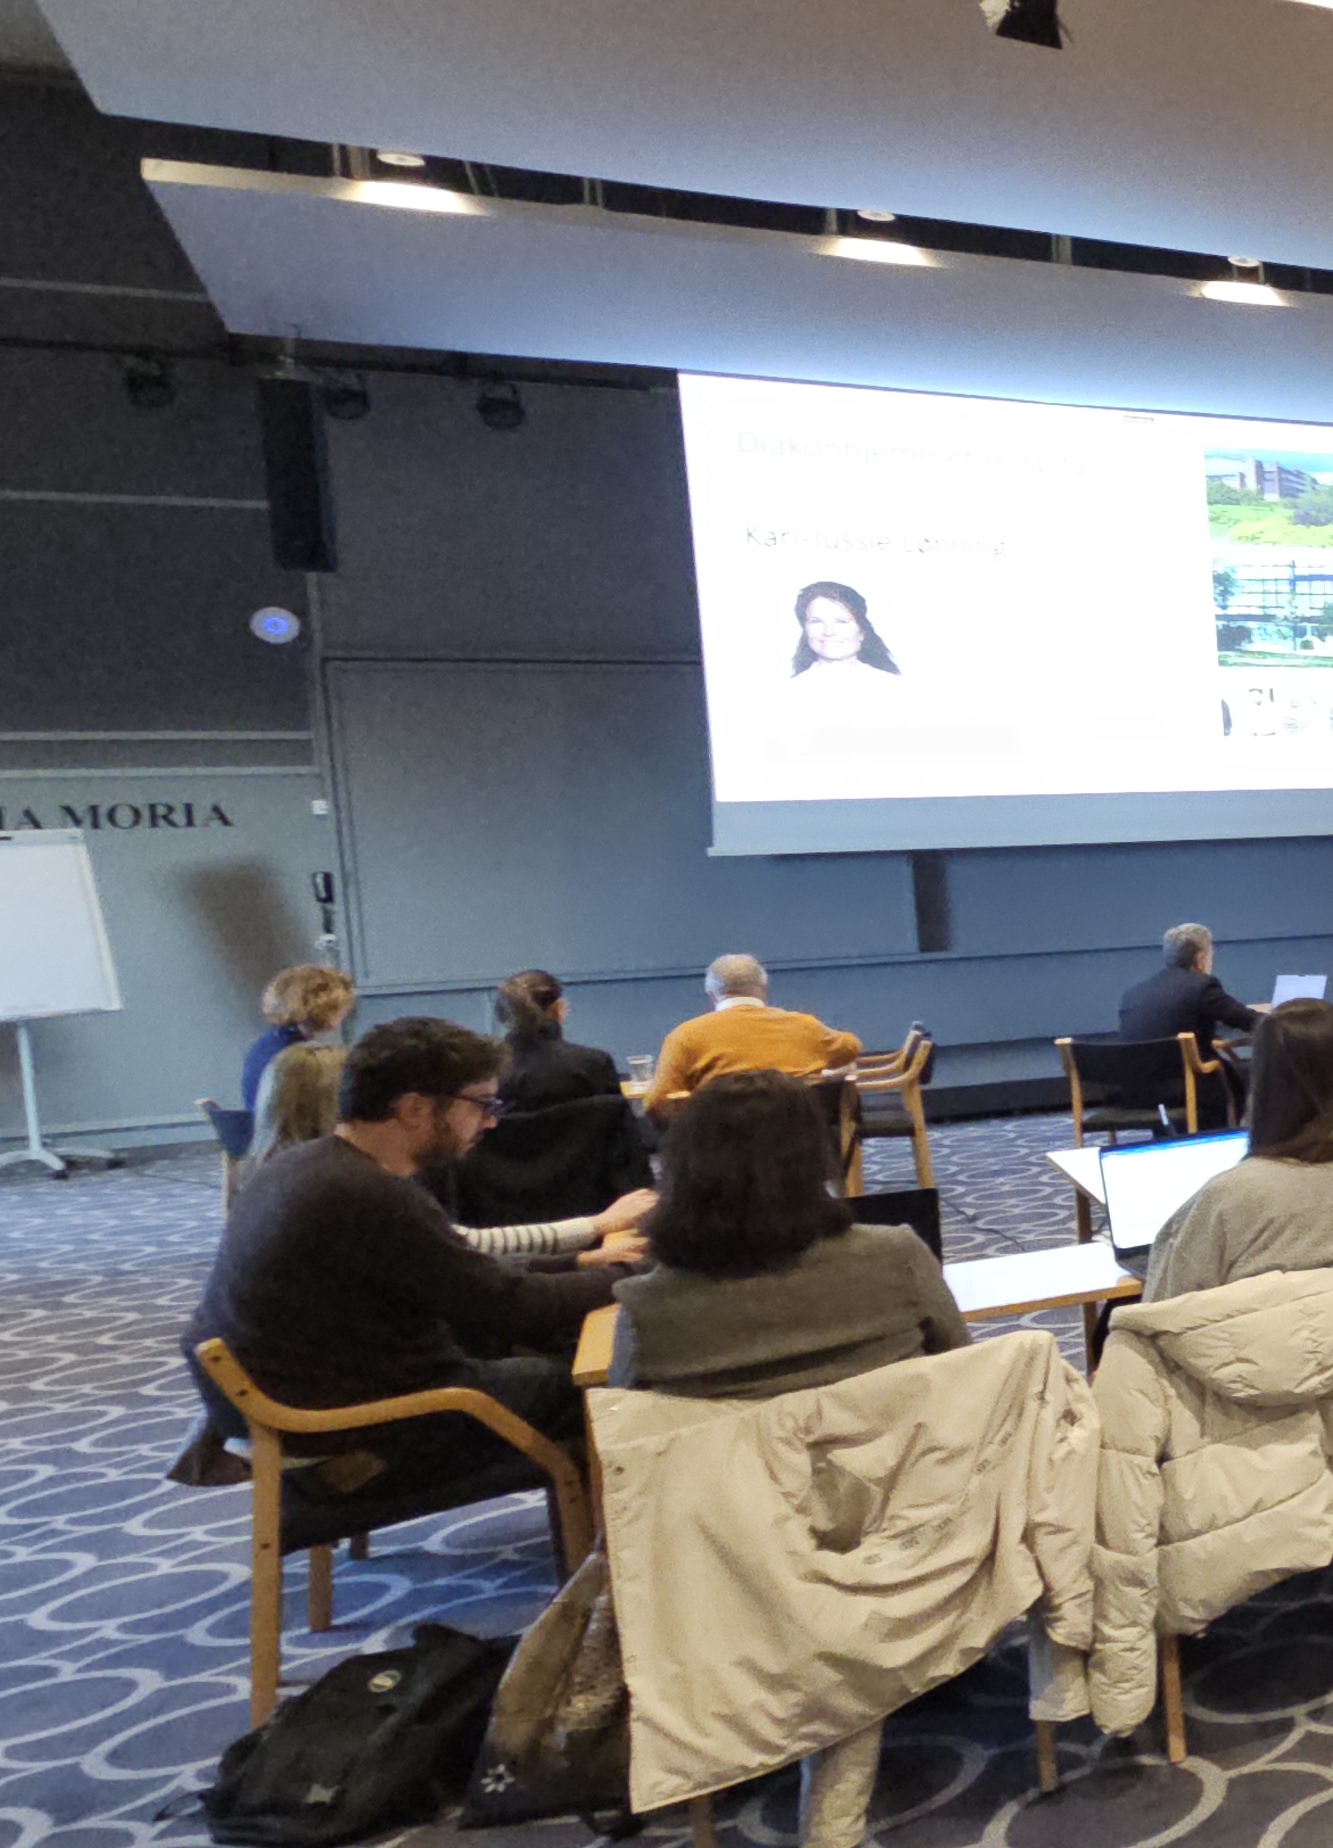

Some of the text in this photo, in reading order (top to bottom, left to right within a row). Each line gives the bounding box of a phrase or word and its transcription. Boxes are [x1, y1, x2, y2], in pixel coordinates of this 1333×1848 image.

[737, 430, 969, 468] Diakonhjemmet
[745, 526, 1008, 562] Kari-Jussie Lønning
[60, 803, 235, 830] MORIA
